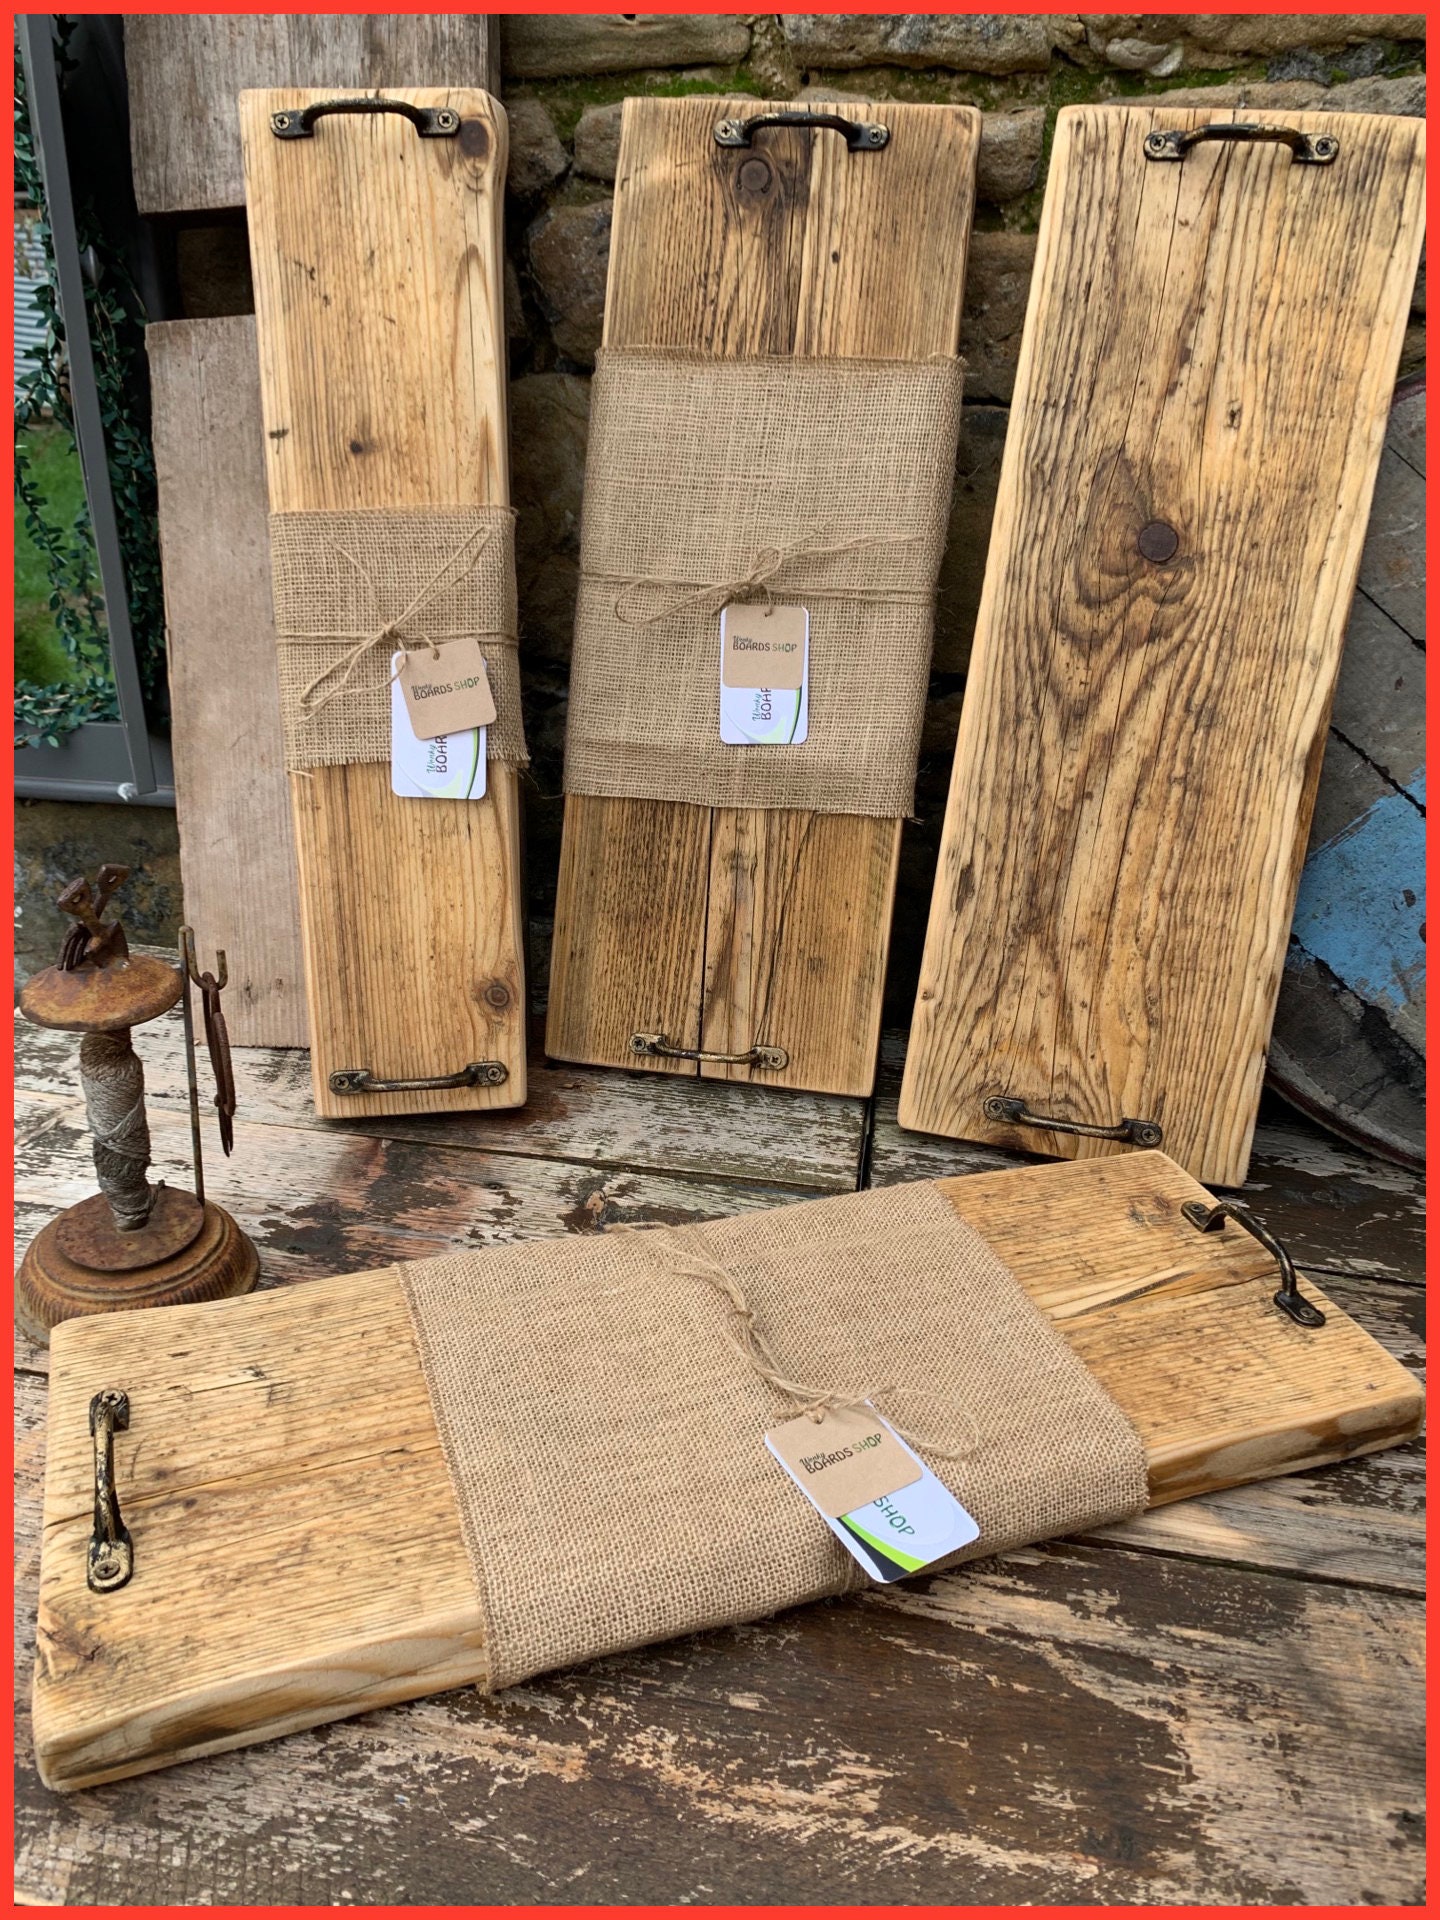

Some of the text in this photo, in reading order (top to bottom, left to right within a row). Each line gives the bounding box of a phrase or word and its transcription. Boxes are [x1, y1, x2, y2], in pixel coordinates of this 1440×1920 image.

[733, 641, 798, 653] BOARDS SHOP
[413, 676, 480, 700] BOARDS SHOP
[804, 1432, 882, 1474] BOARDS SHOP
[873, 1495, 915, 1535] SHOP
